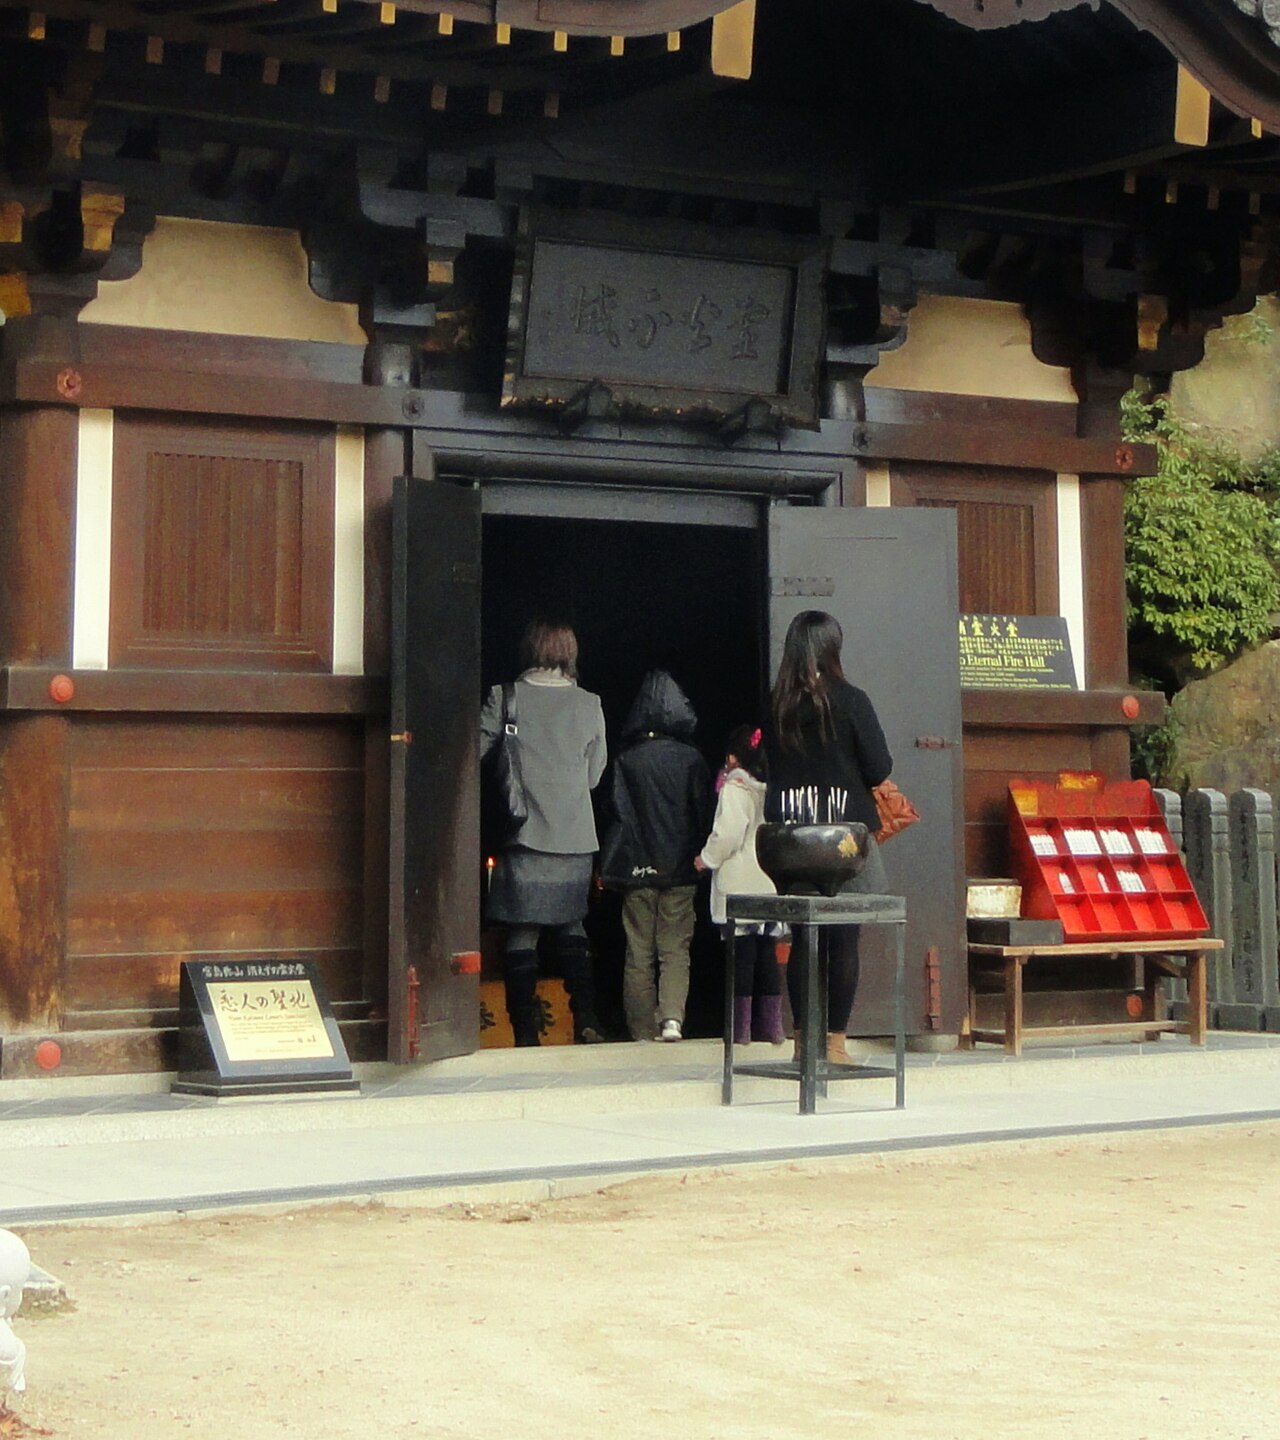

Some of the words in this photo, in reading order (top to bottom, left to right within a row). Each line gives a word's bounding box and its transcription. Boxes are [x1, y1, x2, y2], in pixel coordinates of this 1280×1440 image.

[967, 654, 1003, 667] Eternal
[1004, 655, 1024, 667] Fire
[1025, 656, 1045, 668] Hall
[220, 987, 311, 1013] 恋人の聖地
